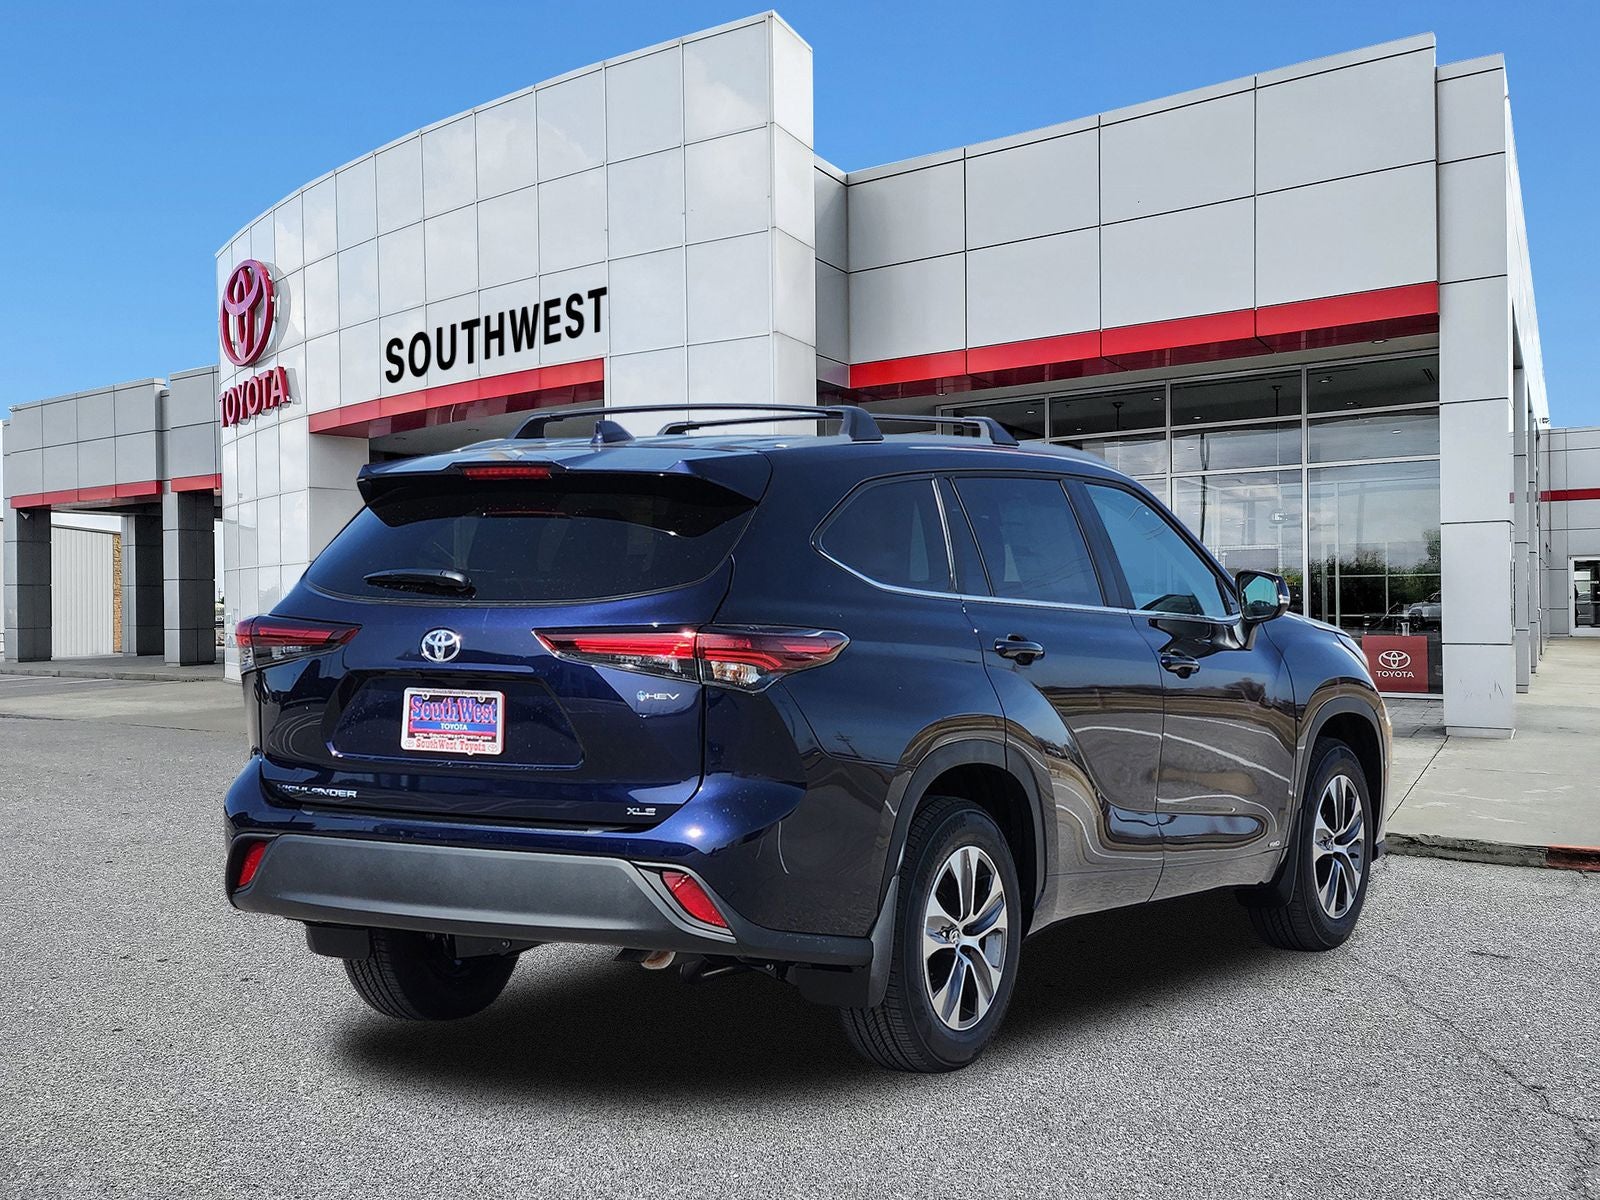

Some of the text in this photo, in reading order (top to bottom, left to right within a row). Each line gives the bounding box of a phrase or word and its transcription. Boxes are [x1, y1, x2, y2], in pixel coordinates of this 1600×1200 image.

[385, 286, 607, 383] SOUTHWEST
[218, 366, 291, 428] TOYOTA
[440, 723, 468, 731] TOYOTA
[460, 741, 486, 751] Toyota
[626, 807, 656, 815] XLE
